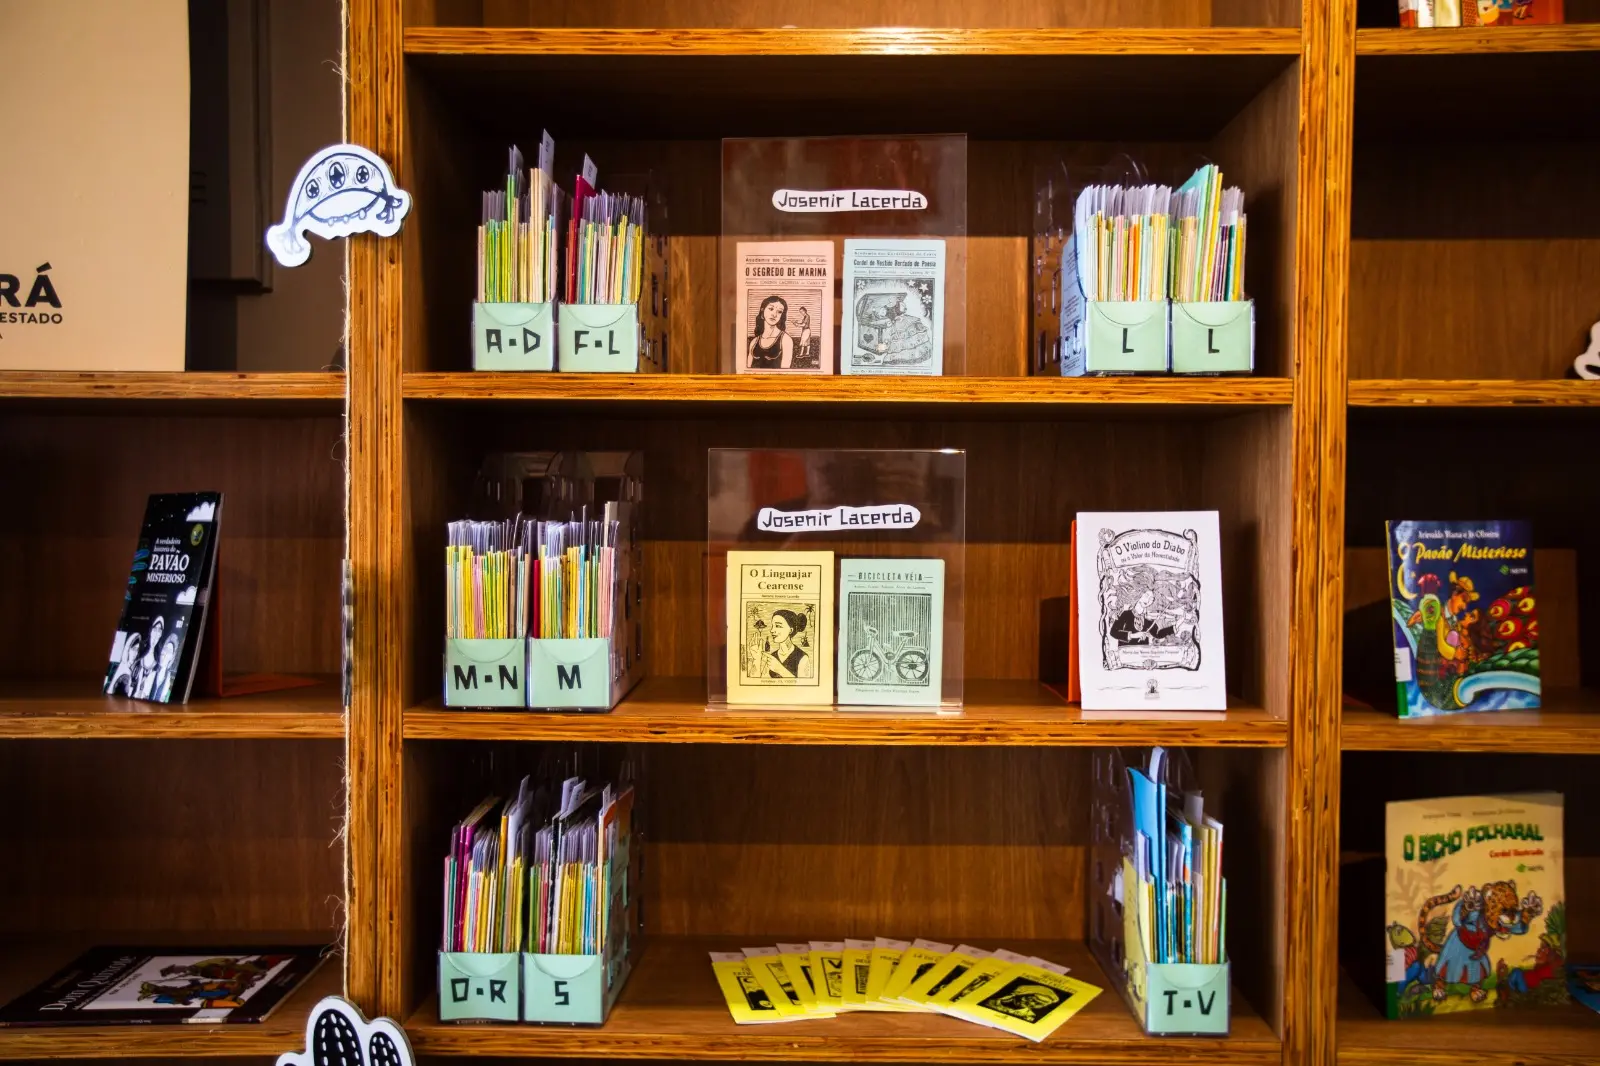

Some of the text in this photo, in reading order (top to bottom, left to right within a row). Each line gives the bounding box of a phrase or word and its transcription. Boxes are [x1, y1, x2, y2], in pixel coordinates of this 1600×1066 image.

[778, 191, 922, 208] Josenir Lacerda
[745, 267, 827, 277] O SEGREDO DE MARINA
[0, 312, 63, 324] ESTADO
[1122, 328, 1134, 354] L
[1208, 328, 1220, 354] L
[762, 507, 914, 528] Josenir Lacerda
[1115, 540, 1185, 555] O Violino do Diabo
[1412, 542, 1453, 564] Pavão
[1453, 543, 1527, 563] Misterioso
[148, 549, 190, 572] PAVÃO
[1131, 552, 1143, 560] Valor
[1151, 551, 1180, 562] Honestidade
[146, 572, 186, 584] MISTERIOSO
[749, 569, 813, 580] O Linguajar
[858, 571, 923, 581] BICICLETA VÉIA
[757, 581, 804, 590] Cearense
[557, 665, 582, 690] M
[1403, 822, 1544, 862] O BICHO FOLHARAL
[554, 981, 570, 1006] S
